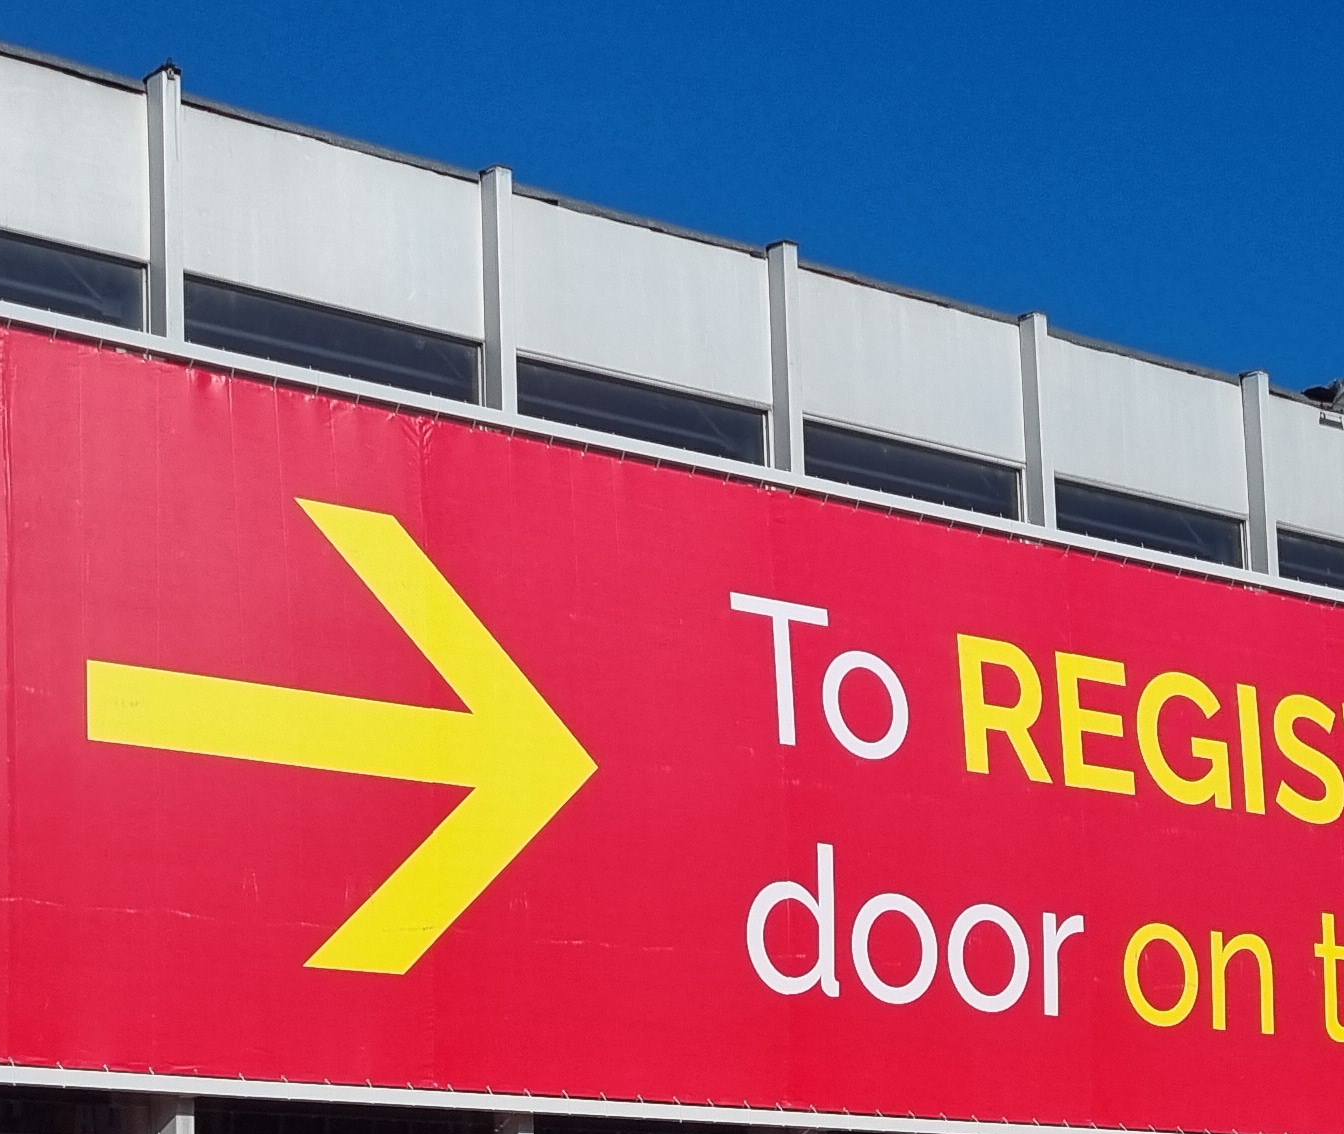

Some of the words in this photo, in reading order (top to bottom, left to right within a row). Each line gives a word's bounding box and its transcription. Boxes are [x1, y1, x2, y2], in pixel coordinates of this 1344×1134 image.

[729, 591, 909, 760] To
[746, 842, 1085, 1017] door
[1123, 922, 1275, 1035] on
